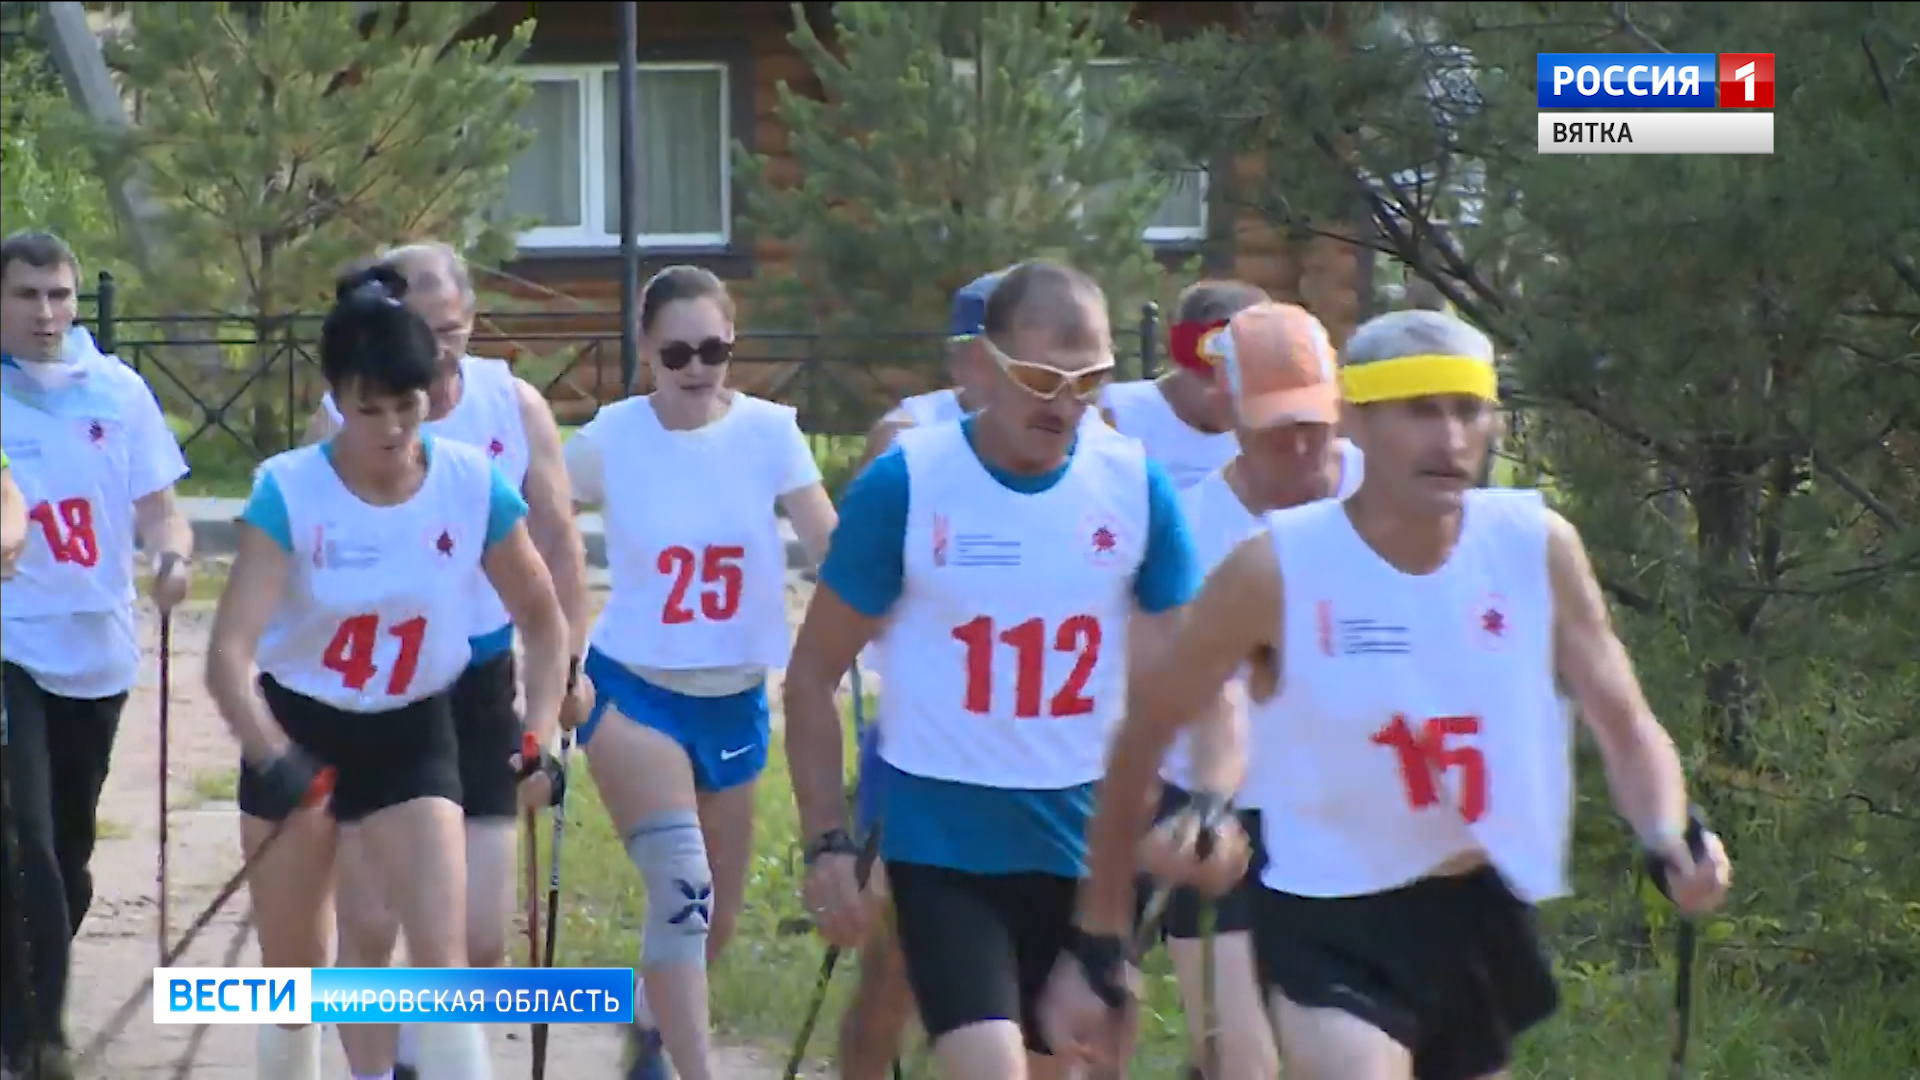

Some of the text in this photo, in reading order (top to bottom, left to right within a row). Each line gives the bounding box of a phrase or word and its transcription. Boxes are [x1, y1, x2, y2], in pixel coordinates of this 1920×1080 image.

[29, 497, 99, 568] 18
[657, 544, 745, 625] 25
[322, 611, 427, 696] 41
[952, 614, 1102, 719] 112
[1371, 713, 1488, 825] 15
